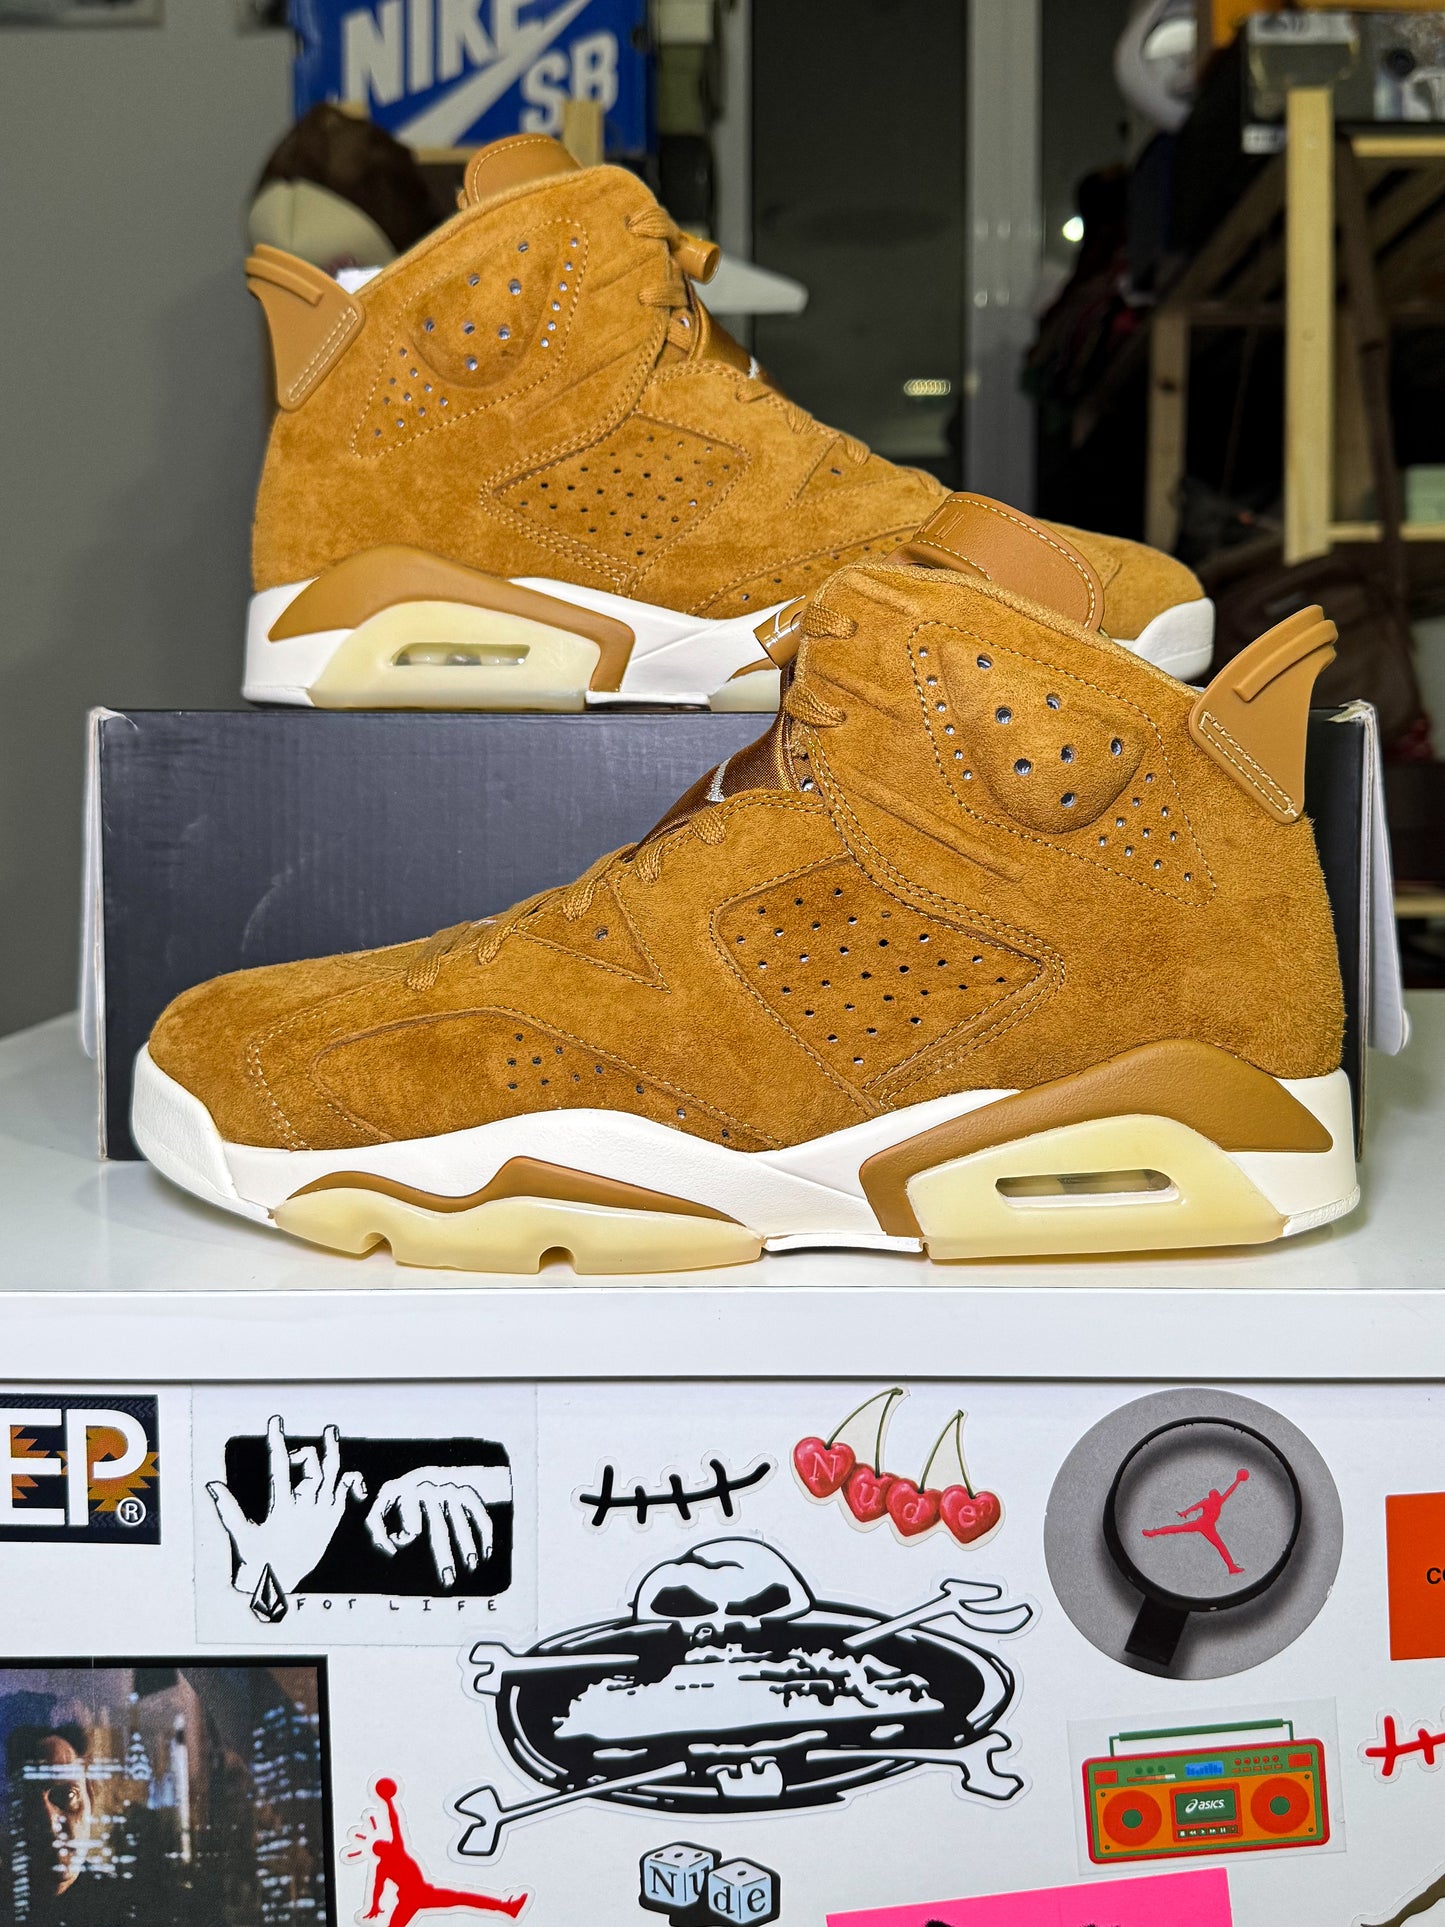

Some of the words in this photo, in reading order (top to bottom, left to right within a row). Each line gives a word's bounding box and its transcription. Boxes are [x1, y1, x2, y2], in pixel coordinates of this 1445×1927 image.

[343, 0, 546, 106] NIKE
[523, 32, 618, 135] SB
[808, 1451, 977, 1528] Nude
[389, 1599, 497, 1612] LIFE
[649, 1864, 766, 1915] Nude
